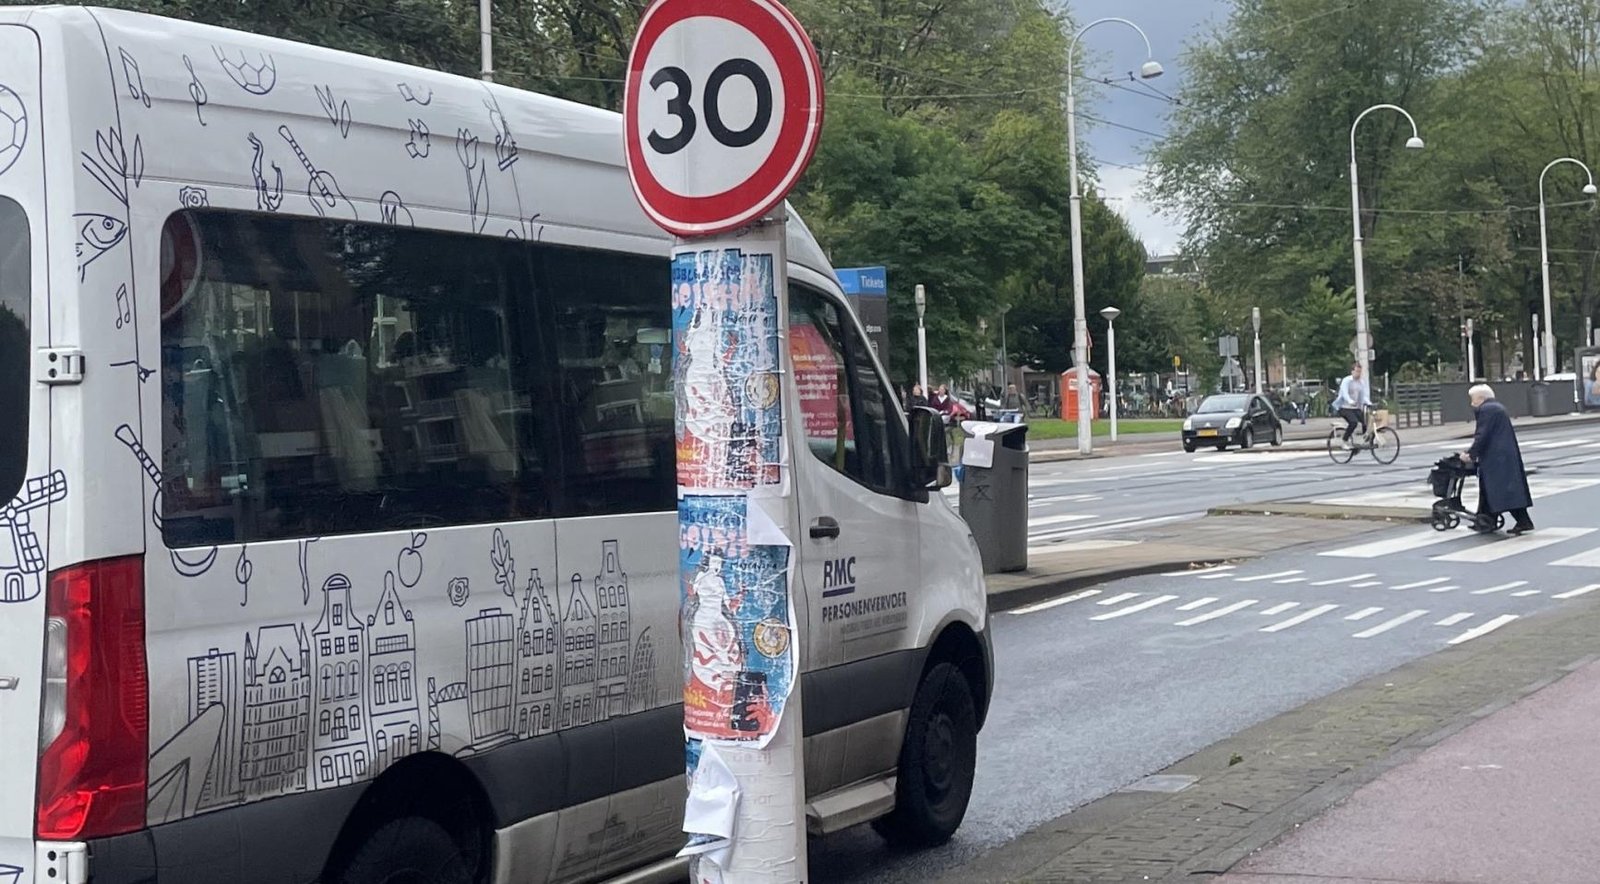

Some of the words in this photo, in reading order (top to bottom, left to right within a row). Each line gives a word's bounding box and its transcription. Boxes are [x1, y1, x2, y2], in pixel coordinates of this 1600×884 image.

[647, 58, 773, 155] 30
[861, 275, 884, 288] Tickets
[823, 556, 856, 589] RMC
[822, 591, 907, 624] PERSONENVERVOER
